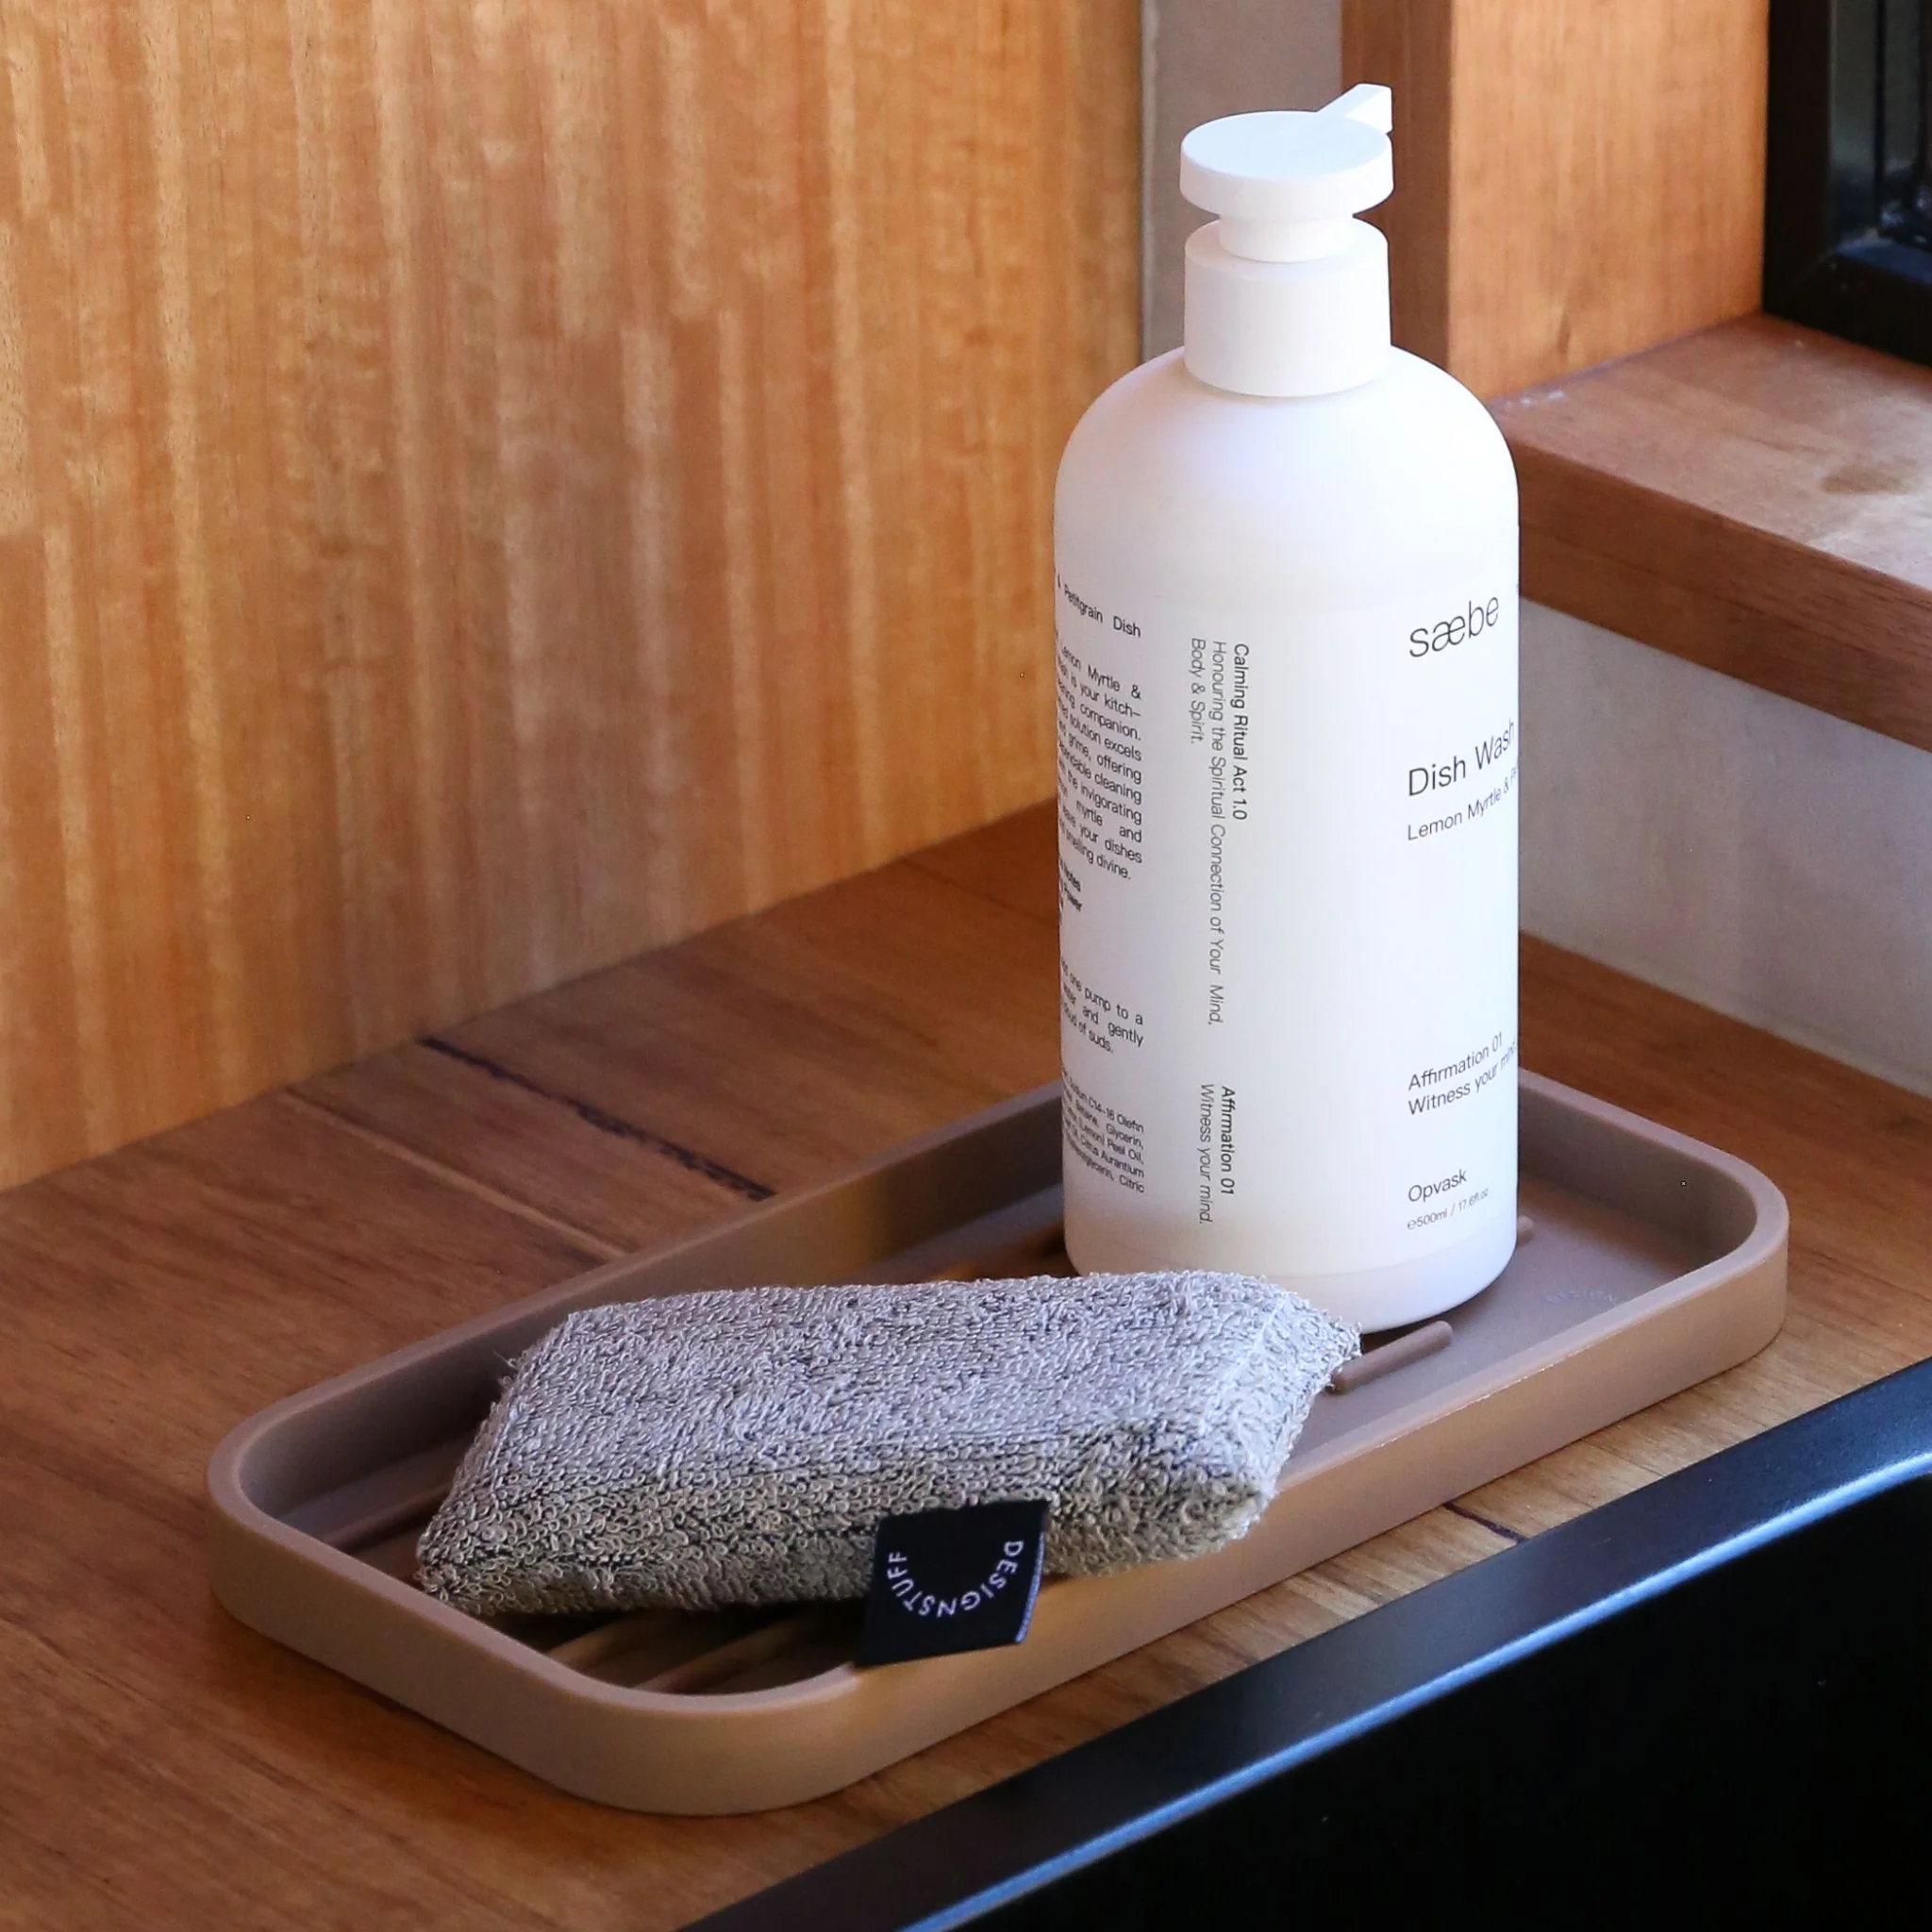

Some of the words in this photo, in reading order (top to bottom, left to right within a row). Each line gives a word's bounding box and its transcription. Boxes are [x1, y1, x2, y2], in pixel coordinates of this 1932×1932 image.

[1113, 616, 1141, 638] Dish
[1409, 596, 1499, 658] sæbe
[1189, 638, 1206, 677] Body
[1230, 643, 1250, 709] Calming
[1080, 683, 1099, 702] your
[1088, 665, 1120, 691] Myrtle
[1131, 684, 1141, 700] &
[1191, 682, 1205, 694] &
[1209, 641, 1226, 722] Honouring
[1070, 714, 1101, 744] solution
[1104, 738, 1141, 761] excels
[1080, 704, 1141, 741] companion.
[1189, 701, 1205, 743] Spirit.
[1211, 727, 1226, 751] the
[1232, 714, 1249, 760] Ritual
[1096, 754, 1141, 784] offering
[1408, 755, 1466, 796] Dish
[1474, 719, 1515, 770] Wash
[1094, 774, 1141, 805] cleaning
[1208, 757, 1226, 819] Spiritual
[1232, 765, 1248, 792] Act
[1076, 800, 1103, 826] myrtle
[1120, 825, 1141, 842] and
[1081, 784, 1141, 825] invigorating
[1232, 798, 1247, 821] 1.0
[1407, 812, 1462, 841] Lemon
[1468, 787, 1501, 819] Myrtle
[1080, 824, 1099, 842] your
[1105, 838, 1142, 863] dishes
[1096, 854, 1131, 880] divine.
[1210, 824, 1226, 911] Connection
[1210, 916, 1224, 933] of
[1208, 939, 1224, 974] Your
[1085, 988, 1110, 1012] pump
[1116, 1004, 1128, 1020] to
[1135, 1014, 1143, 1024] a
[1208, 984, 1224, 1025] Mind,
[1083, 1006, 1098, 1024] and
[1108, 1022, 1143, 1047] gently
[1089, 1030, 1114, 1053] suds.
[1408, 1045, 1489, 1091] Affirmation
[1491, 1031, 1503, 1054] 01
[1407, 1082, 1471, 1116] Witness
[1474, 1064, 1498, 1093] your
[1117, 1115, 1144, 1133] Olefin
[1200, 1084, 1214, 1142] Witness
[1221, 1086, 1236, 1172] Affirmation
[1106, 1123, 1144, 1150] Glycerin,
[1107, 1137, 1125, 1156] Peel
[1127, 1150, 1144, 1165] Oil,
[1101, 1150, 1144, 1178] Aurantium
[1197, 1148, 1211, 1181] your
[1119, 1174, 1145, 1193] Citric
[1221, 1178, 1235, 1194] 01
[1408, 1169, 1467, 1203] Opvask
[1199, 1185, 1213, 1224] mind.
[887, 1541, 1024, 1618] DESIGNSTUFF
